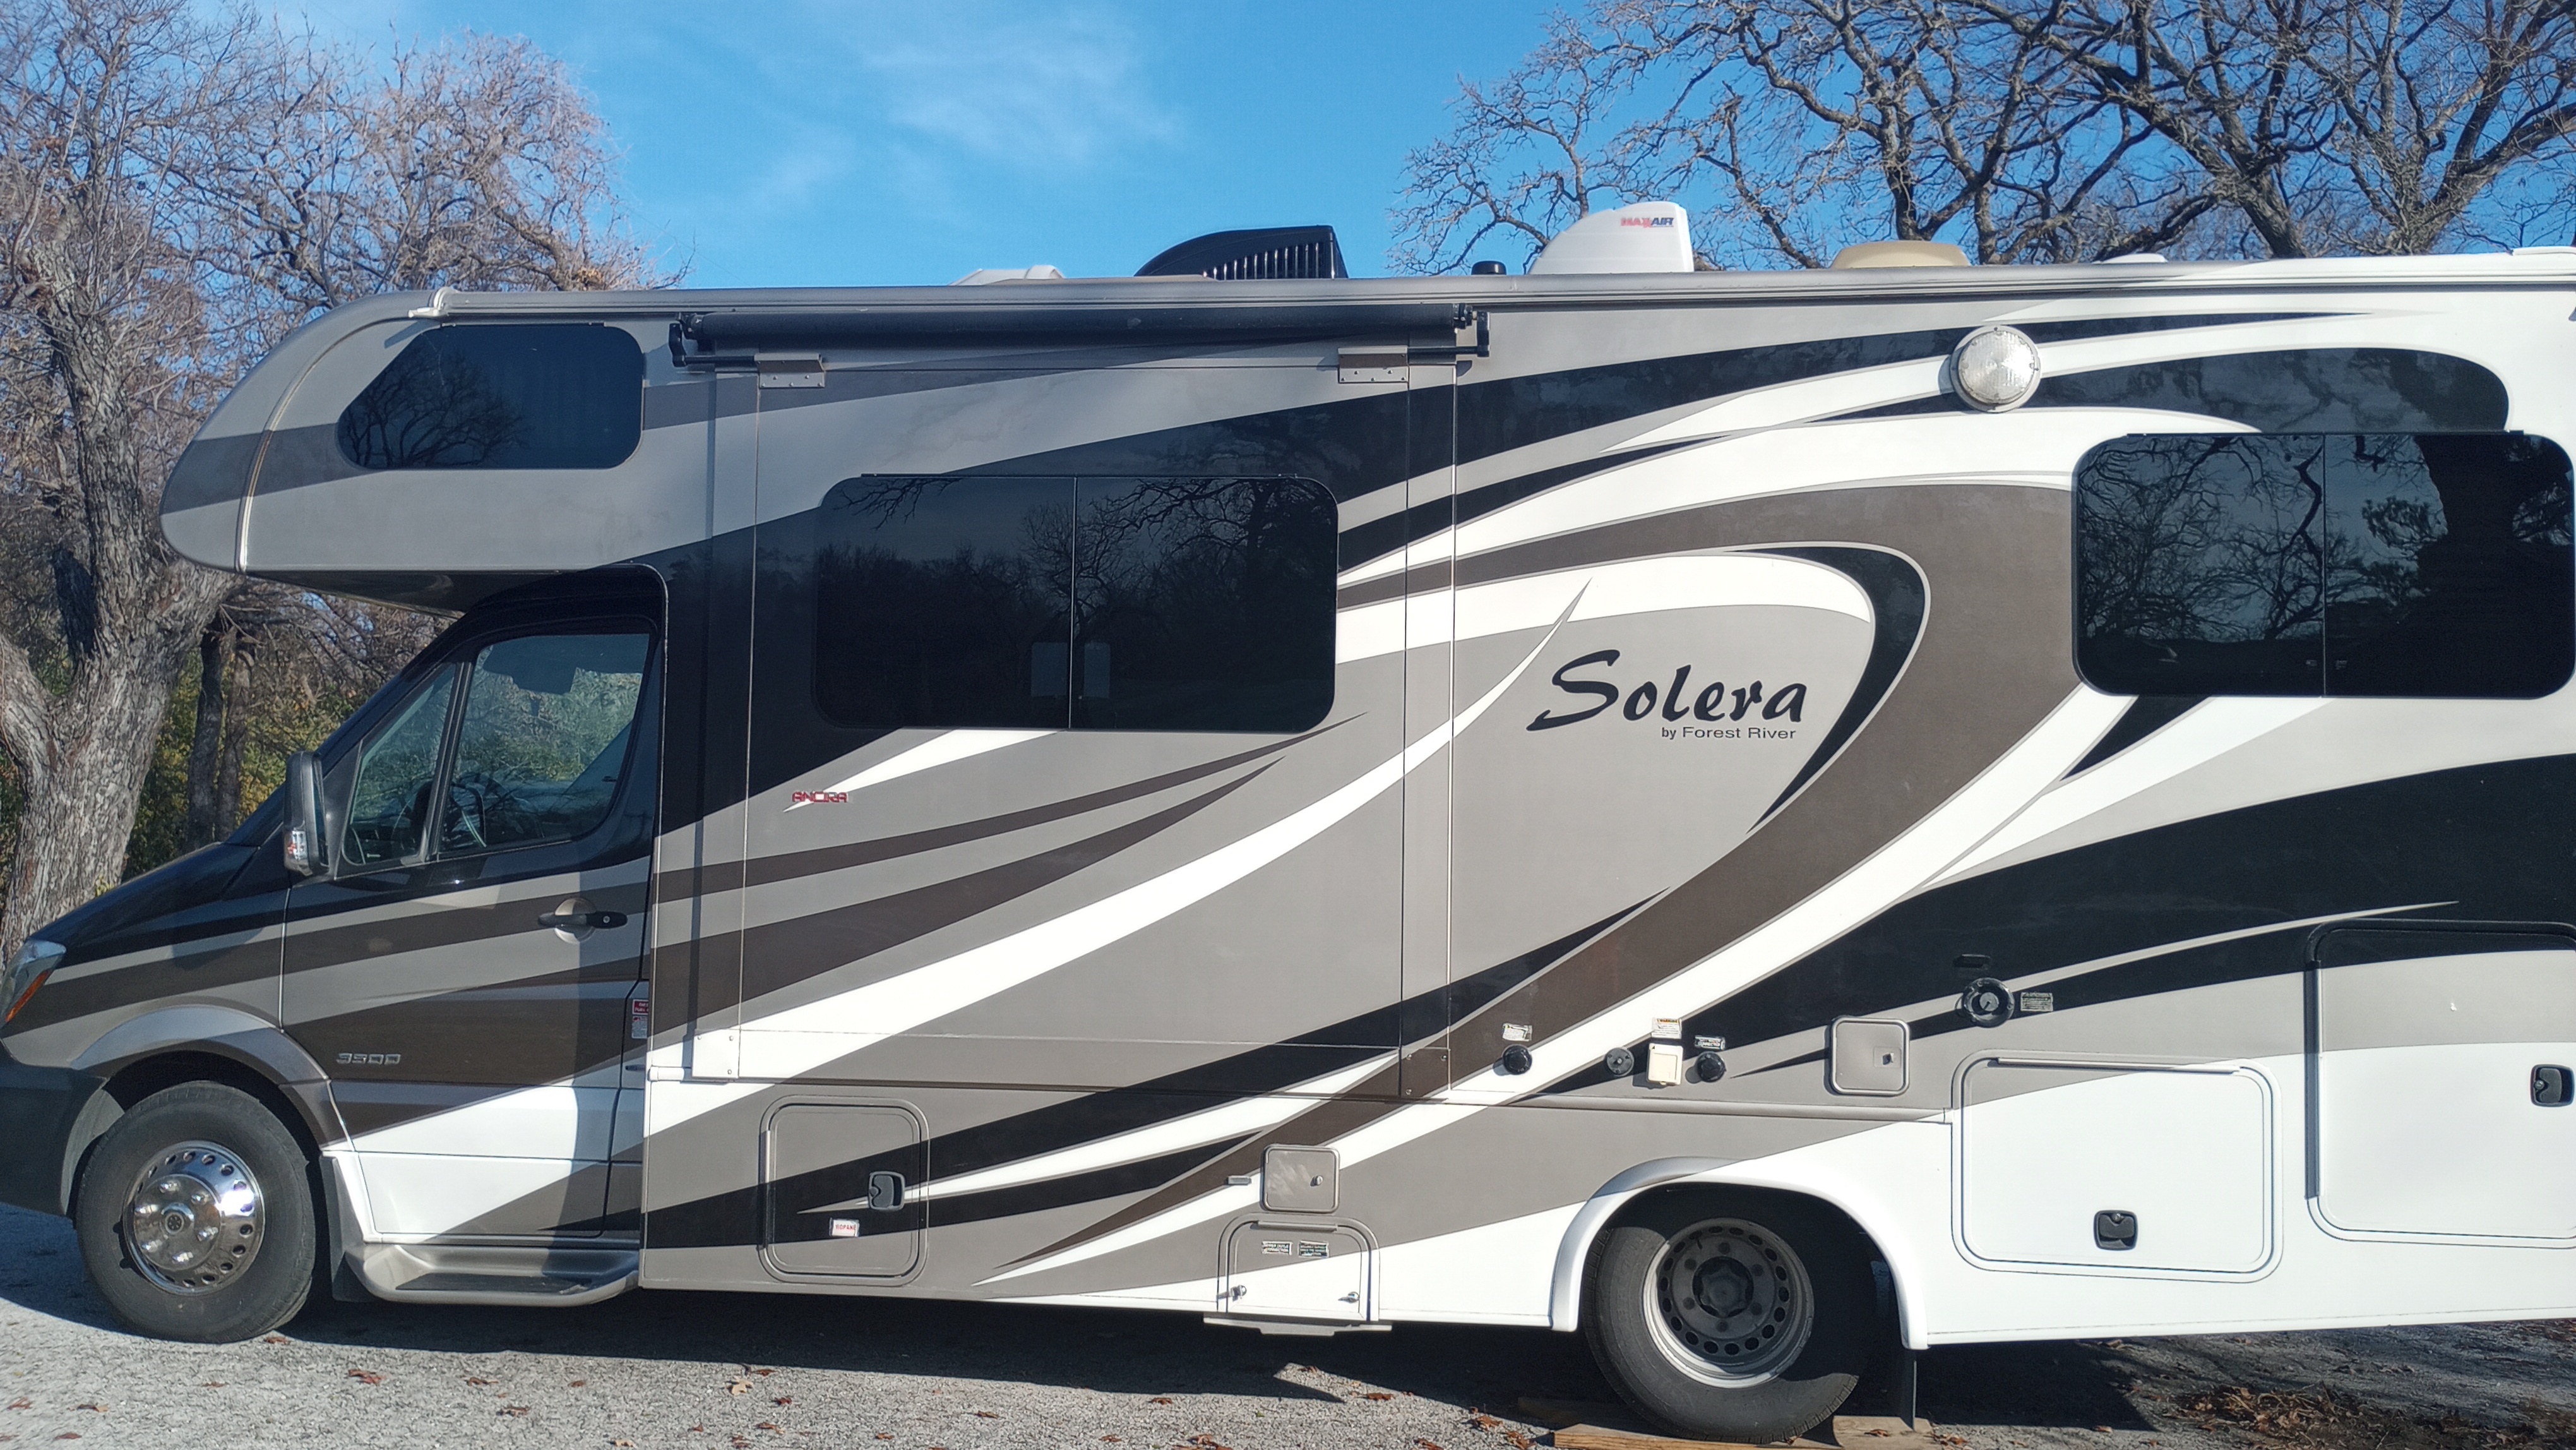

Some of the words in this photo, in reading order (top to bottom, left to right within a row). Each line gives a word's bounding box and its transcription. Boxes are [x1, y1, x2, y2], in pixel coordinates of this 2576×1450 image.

[1525, 649, 1808, 731] Solera
[1661, 726, 1677, 740] by
[1683, 726, 1741, 739] Forest
[1748, 727, 1797, 740] River
[336, 1052, 402, 1065] 3500
